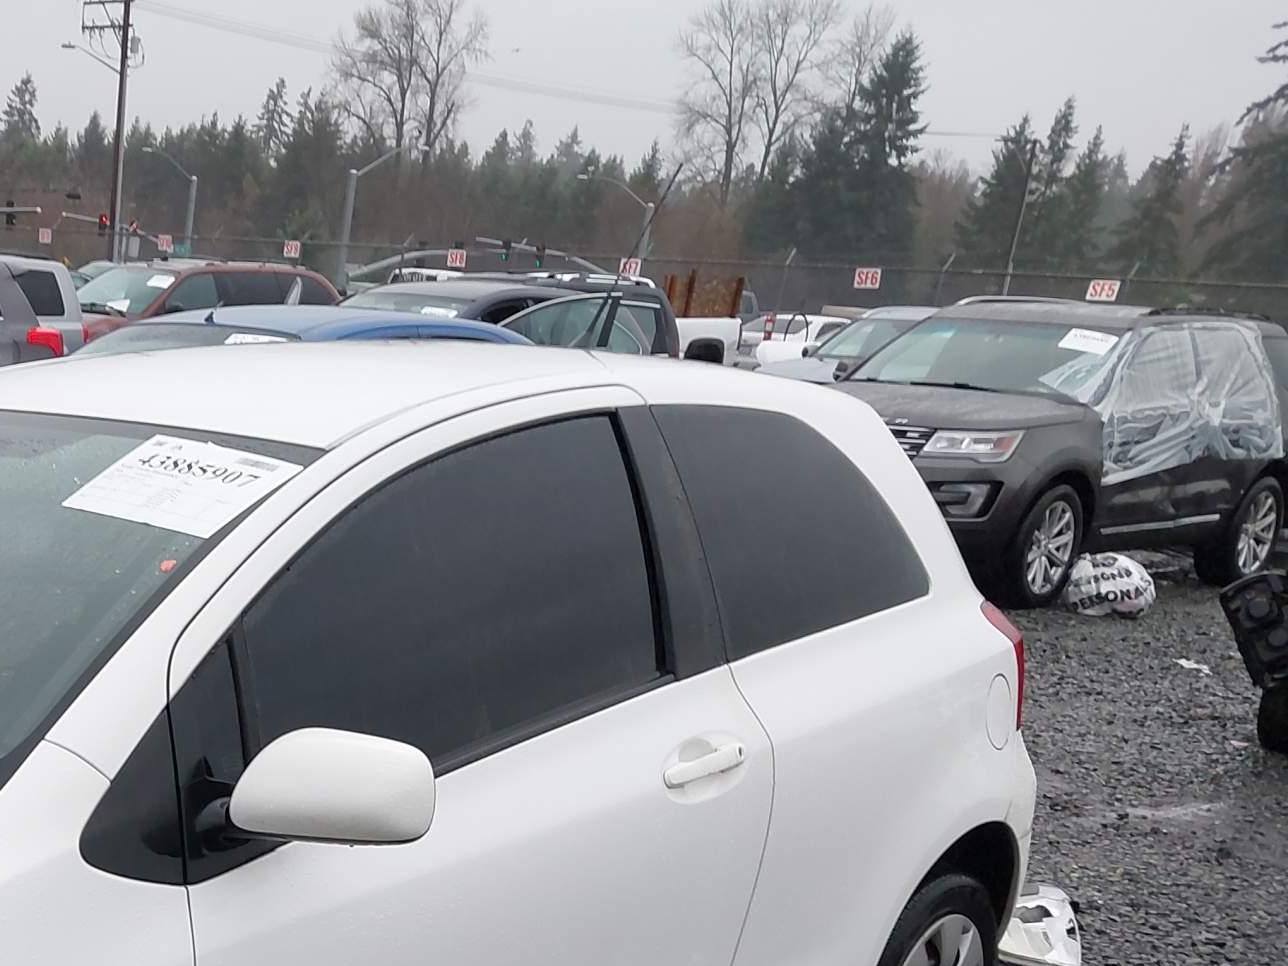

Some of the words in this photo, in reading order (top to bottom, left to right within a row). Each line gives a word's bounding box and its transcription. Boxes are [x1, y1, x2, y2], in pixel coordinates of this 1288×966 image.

[856, 270, 880, 286] SF6
[1089, 281, 1118, 298] SF5
[138, 454, 261, 488] 43885907
